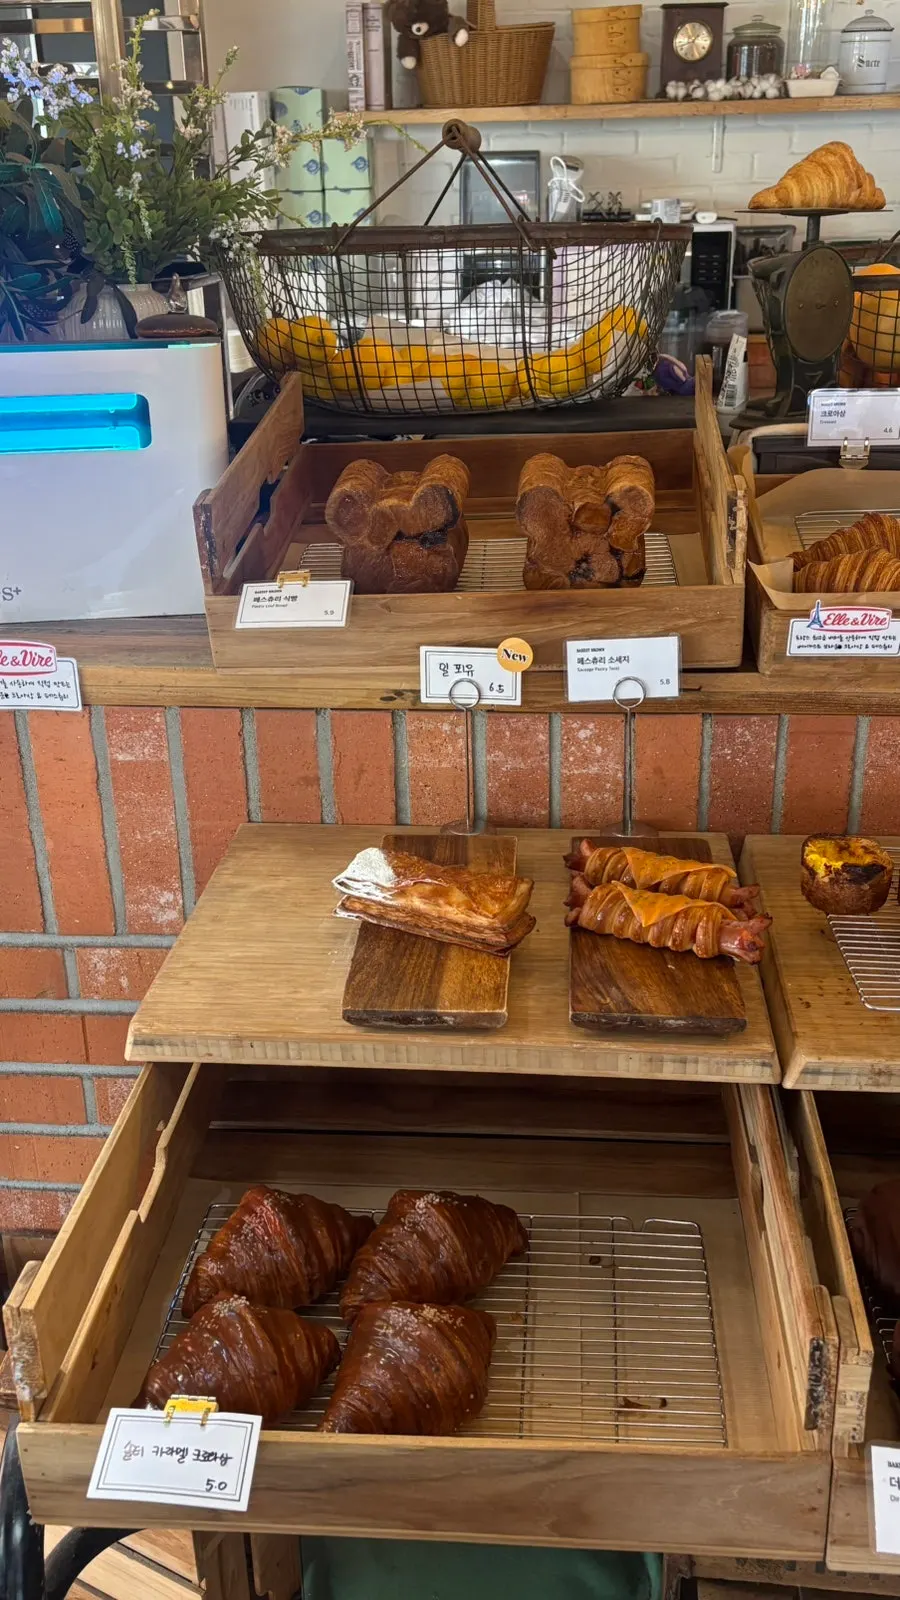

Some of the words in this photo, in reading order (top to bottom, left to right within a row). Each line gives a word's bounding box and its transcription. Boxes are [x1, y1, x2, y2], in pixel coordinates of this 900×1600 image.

[820, 410, 846, 418] 크로아상
[283, 594, 298, 602] 식빵
[823, 613, 850, 626] Elle
[861, 613, 887, 626] Vire
[20, 649, 53, 667] Vire
[501, 648, 528, 662] New
[608, 655, 630, 664] 소세지
[205, 1479, 227, 1492] 5.0
